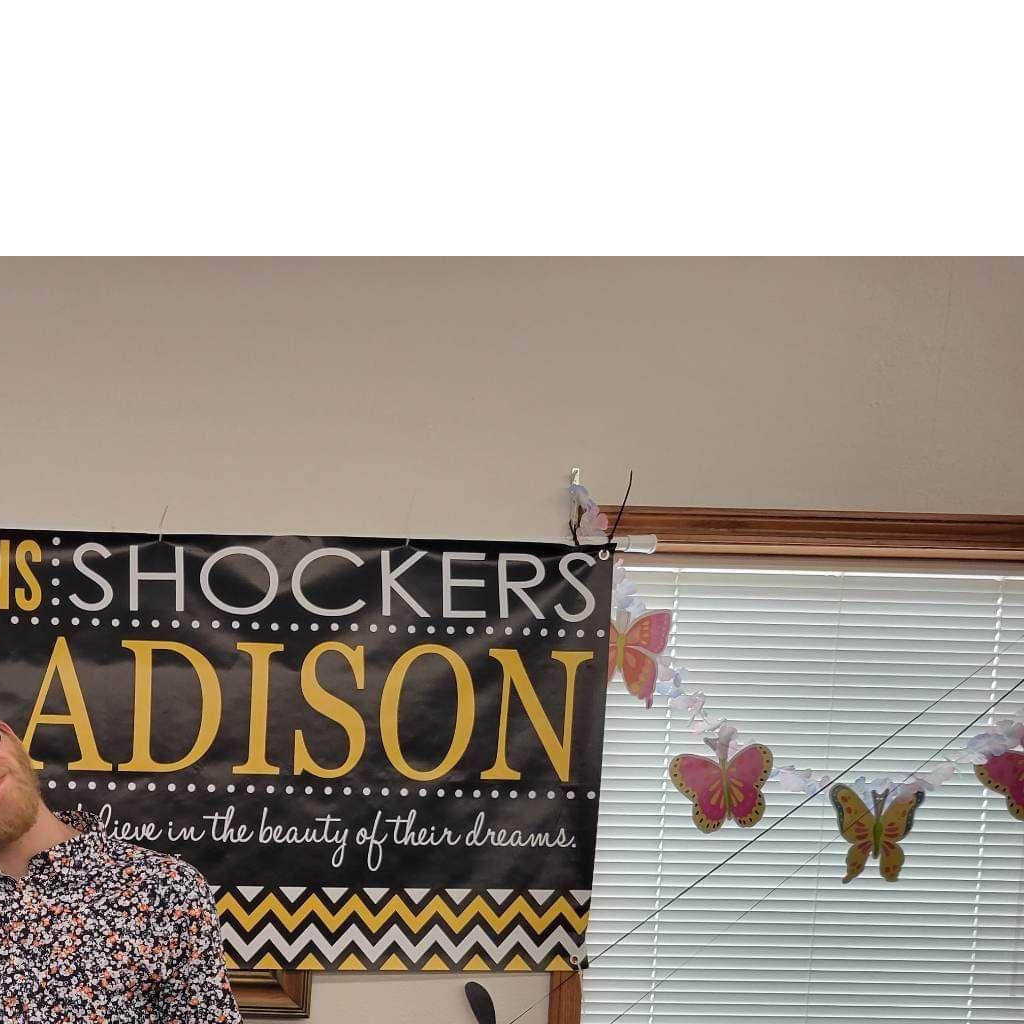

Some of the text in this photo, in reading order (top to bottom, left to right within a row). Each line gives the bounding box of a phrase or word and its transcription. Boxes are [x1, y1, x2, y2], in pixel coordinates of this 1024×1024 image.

[69, 542, 597, 623] SHOCKERS
[168, 821, 206, 841] in
[202, 805, 254, 843] the
[259, 806, 350, 868] beauty
[355, 809, 388, 872] of
[385, 808, 462, 846] their
[465, 811, 577, 848] dreams.
